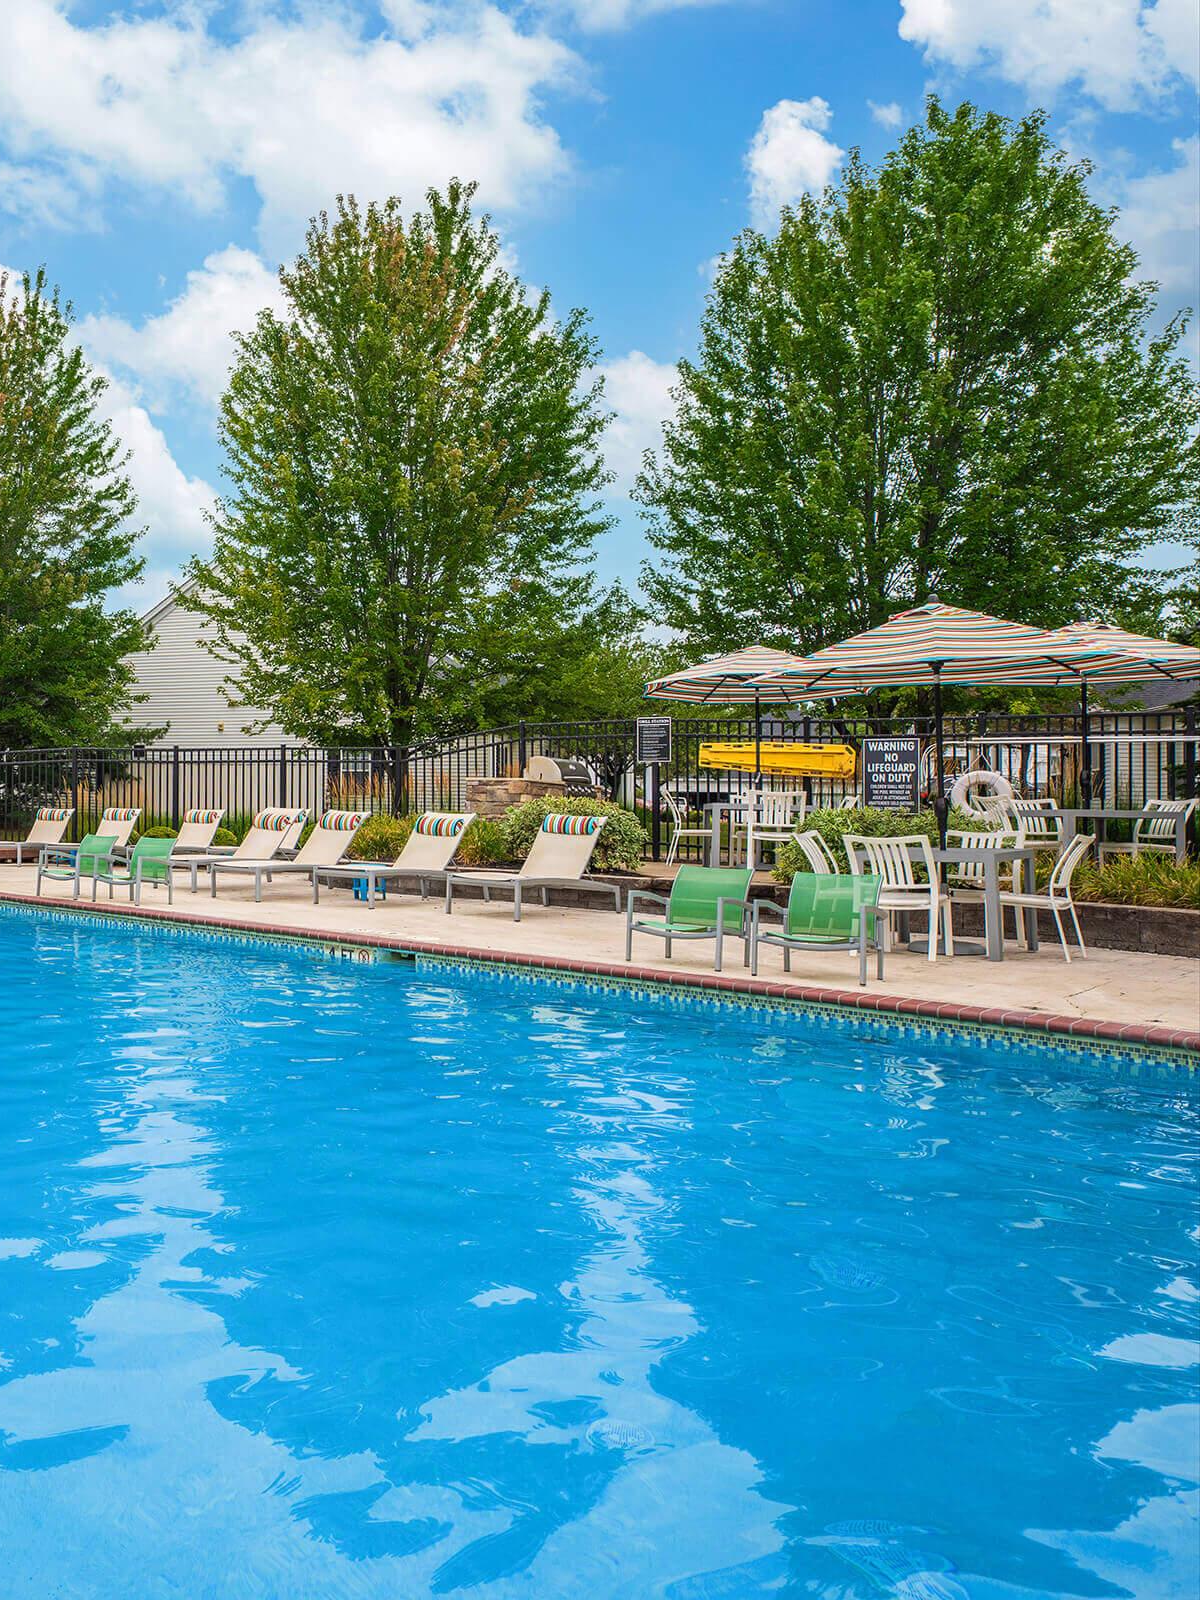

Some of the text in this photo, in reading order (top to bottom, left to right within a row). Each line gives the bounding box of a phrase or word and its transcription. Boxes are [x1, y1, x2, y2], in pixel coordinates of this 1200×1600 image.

[868, 741, 915, 751] WARNING
[884, 753, 898, 762] NO
[867, 763, 916, 772] LIFEGUARD
[872, 773, 912, 782] ON DUTY
[341, 948, 354, 960] FT
